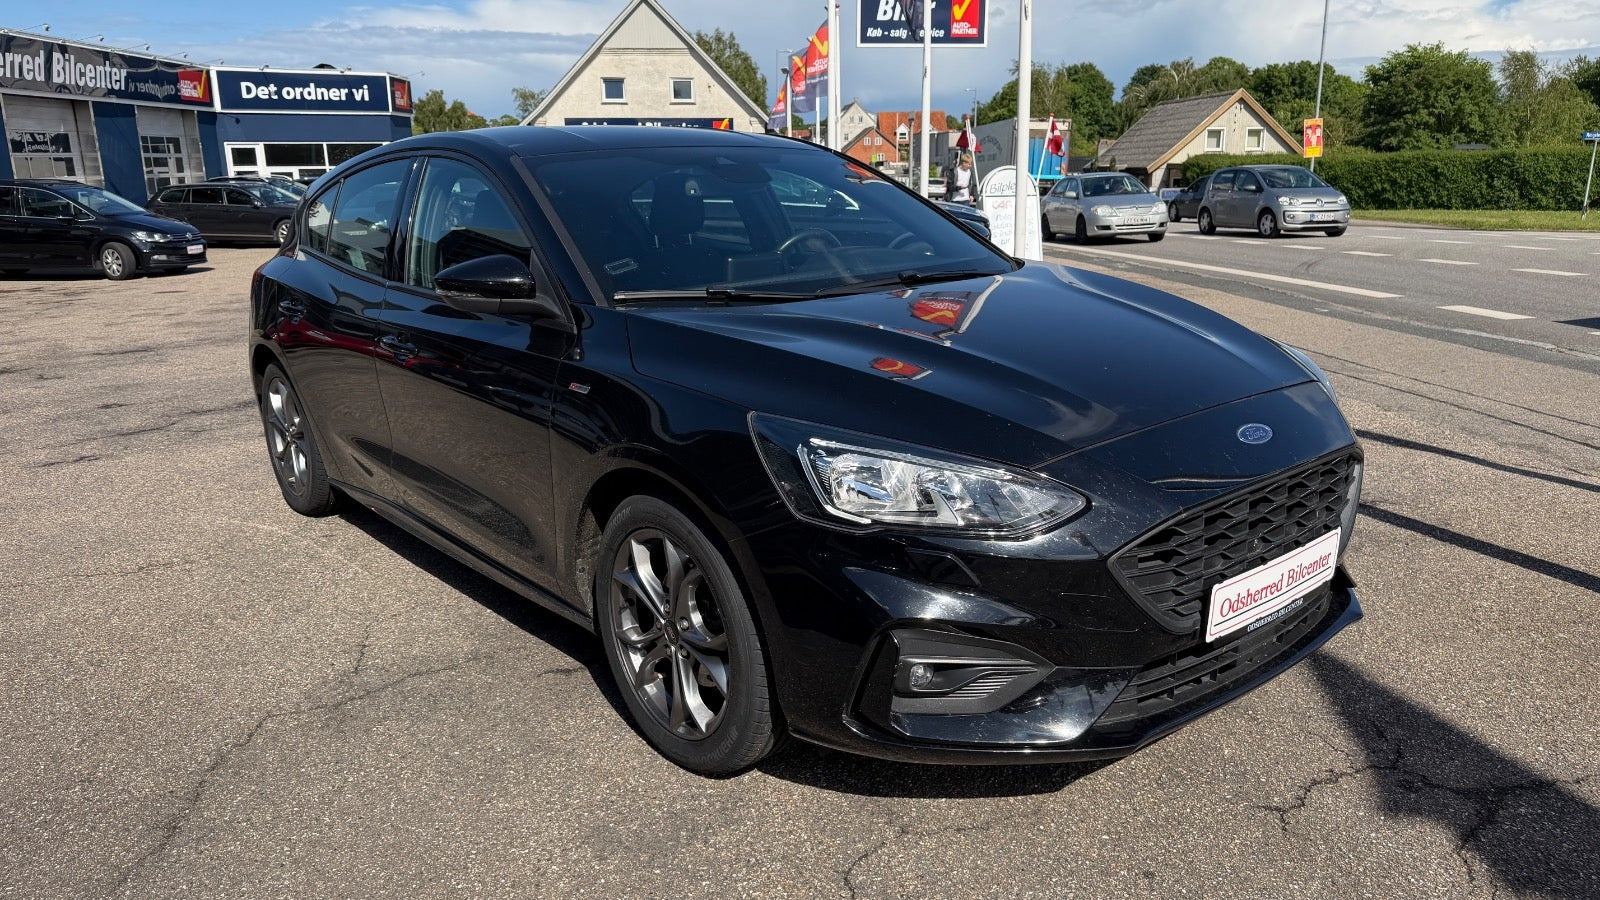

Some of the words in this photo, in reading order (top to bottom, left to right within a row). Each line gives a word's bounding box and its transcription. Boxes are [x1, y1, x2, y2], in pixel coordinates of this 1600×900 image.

[866, 27, 883, 37] Køb
[889, 27, 908, 39] salg
[52, 51, 127, 91] Bilcenter
[240, 81, 278, 99] Det
[281, 83, 349, 101] ordner
[352, 85, 369, 102] vi
[1220, 573, 1284, 618] Odsherred
[1285, 552, 1331, 588] Bilcenter
[1247, 611, 1279, 632] ODSHERRED
[1278, 597, 1304, 617] BILCENTER
